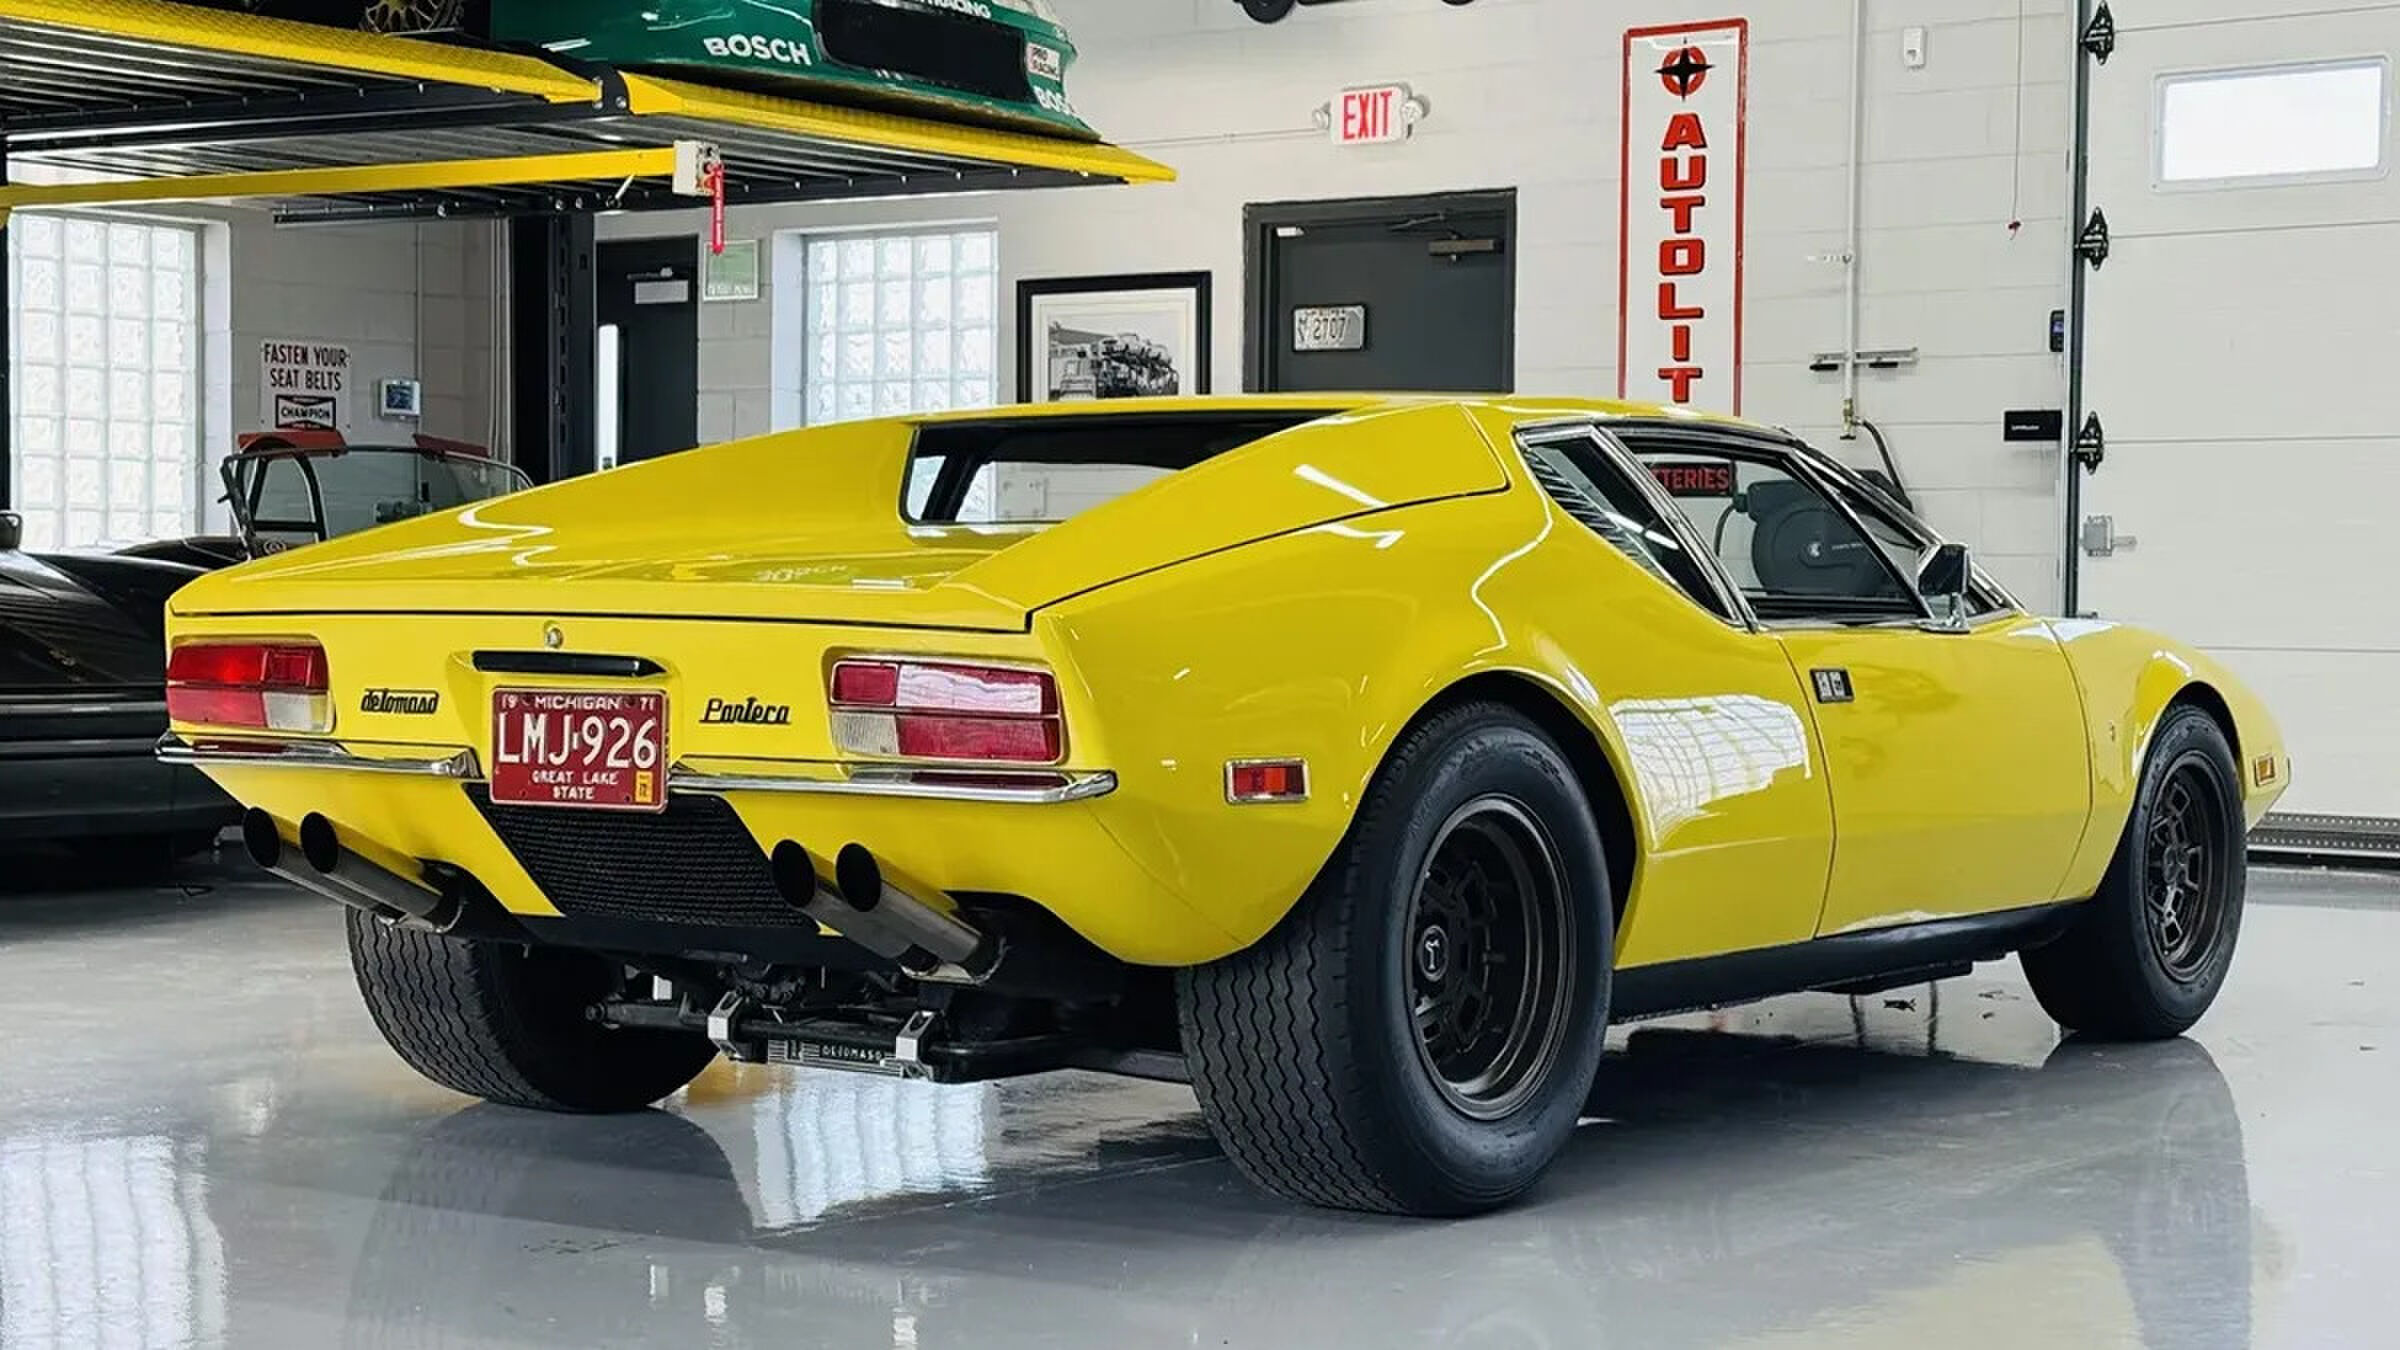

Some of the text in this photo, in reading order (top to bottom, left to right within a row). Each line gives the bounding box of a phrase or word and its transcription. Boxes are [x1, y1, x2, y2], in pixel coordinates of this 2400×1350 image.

[703, 34, 812, 66] BOSCH
[1343, 91, 1392, 140] EXIT
[264, 344, 348, 368] FASTEN YOUR
[270, 368, 342, 391] SEAT BELTS
[281, 406, 331, 418] CHAMPION
[502, 694, 655, 711] 19 MICHIGAN 71
[699, 697, 791, 725] Pantera
[532, 770, 619, 785] GREAT LAKE
[553, 785, 595, 800] STATE
